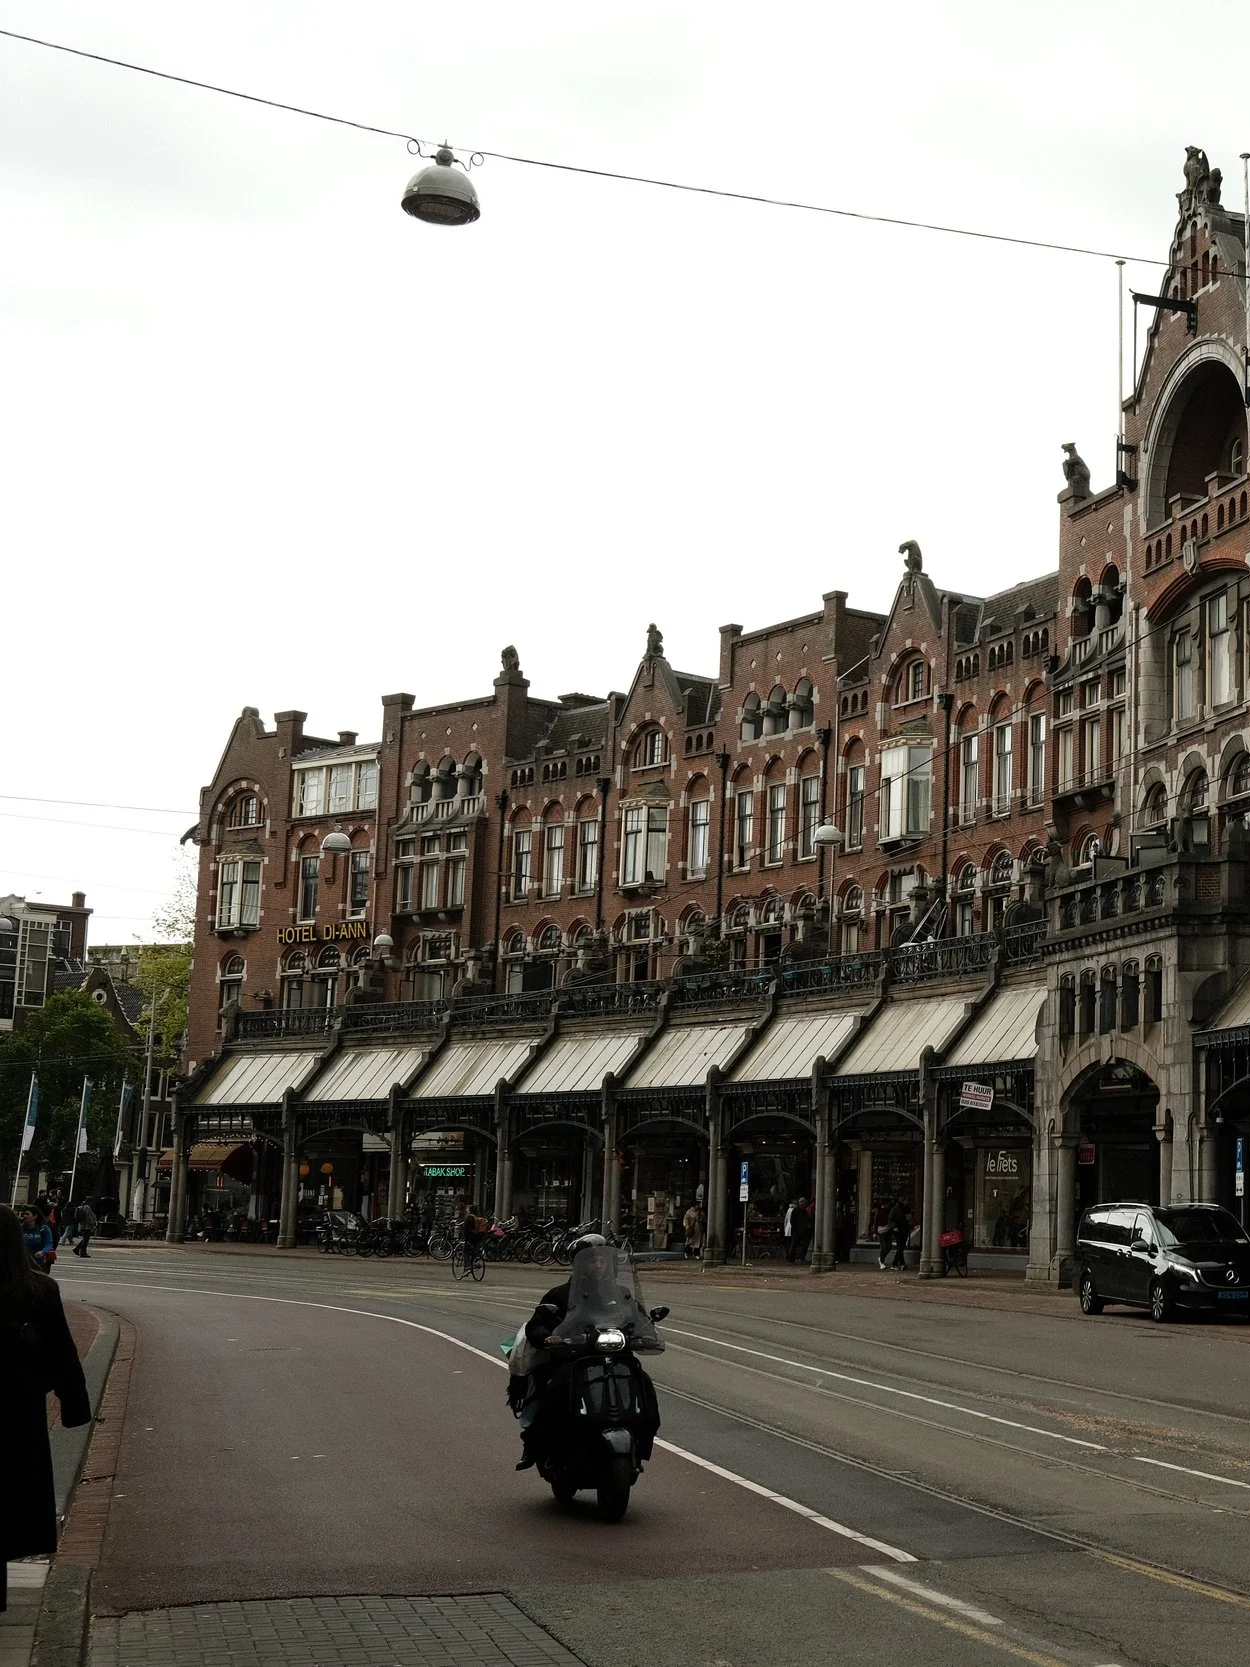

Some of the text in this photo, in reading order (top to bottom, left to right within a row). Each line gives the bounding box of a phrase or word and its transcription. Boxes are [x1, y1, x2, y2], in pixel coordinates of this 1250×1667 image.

[277, 921, 367, 944] HOTEL DI-ANN
[965, 1083, 992, 1096] TE HUUR
[424, 1167, 467, 1177] TABAK SHOP
[742, 1164, 748, 1176] P
